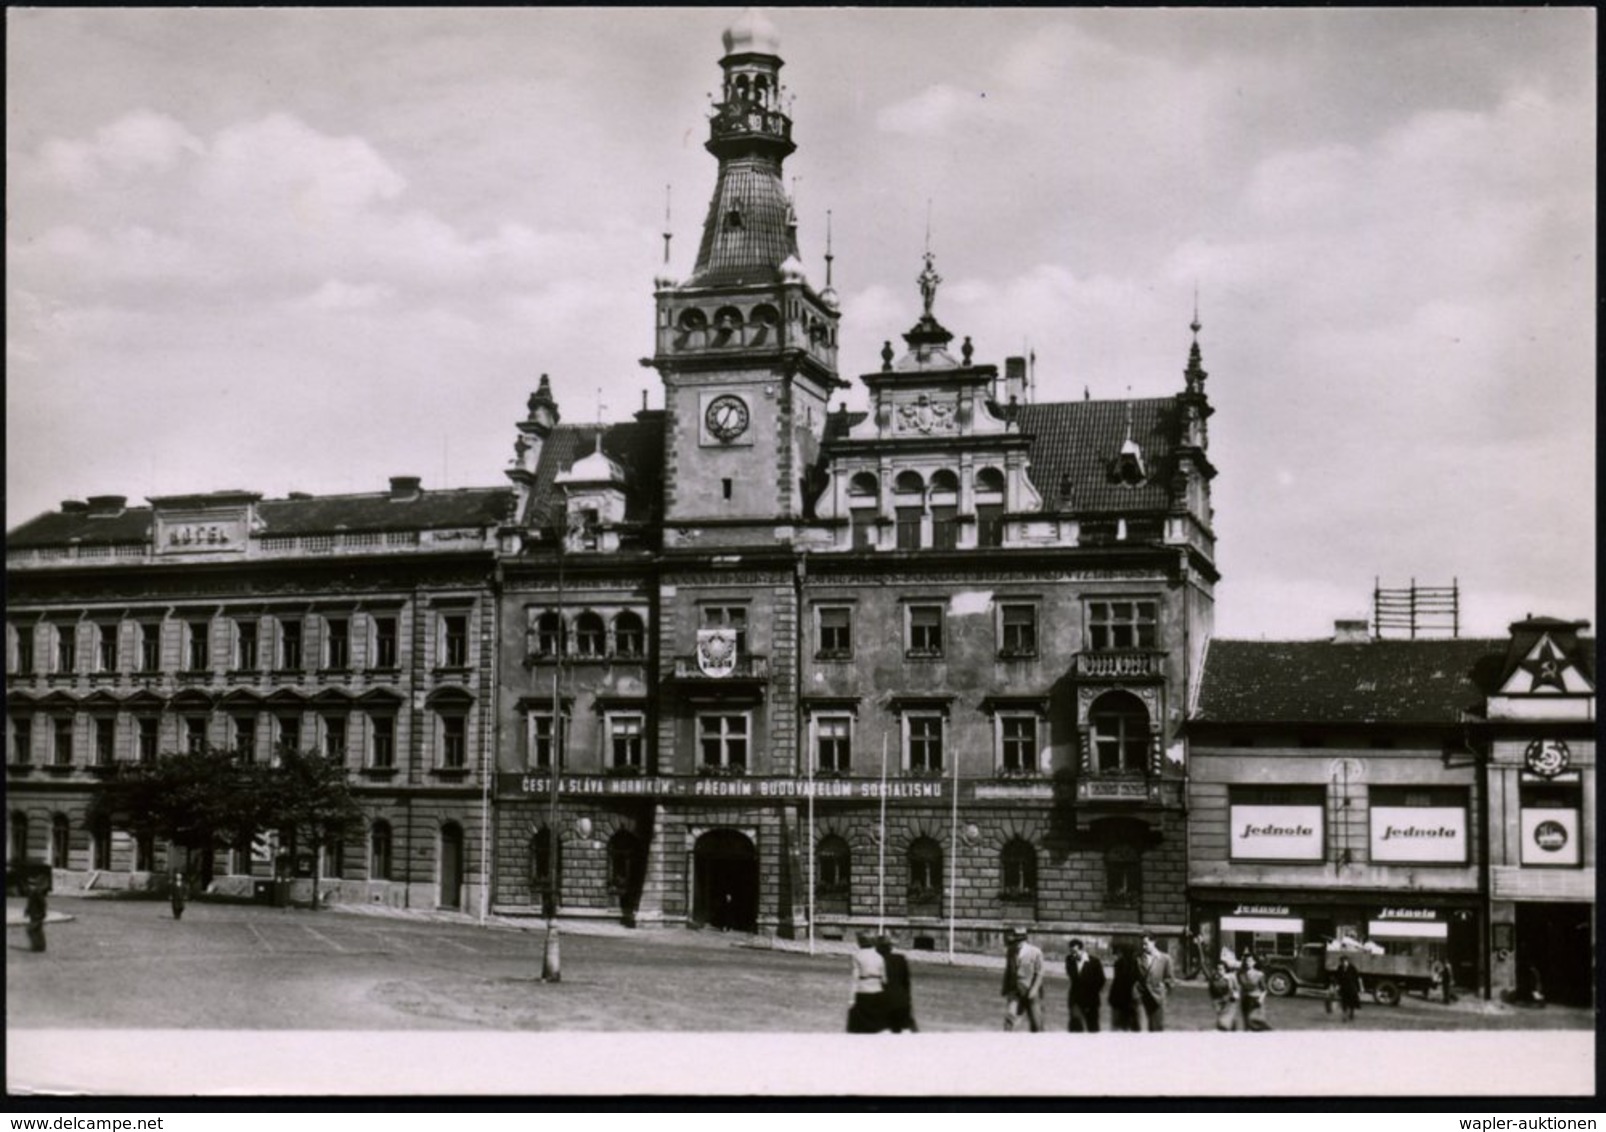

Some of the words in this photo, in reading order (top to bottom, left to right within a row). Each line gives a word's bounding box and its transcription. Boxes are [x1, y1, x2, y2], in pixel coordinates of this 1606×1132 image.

[558, 778, 566, 793] A
[568, 776, 605, 794] SLÁVA
[861, 782, 942, 798] SOCIALISMU
[1240, 824, 1313, 839] Jednota
[1381, 826, 1456, 841] Jednota
